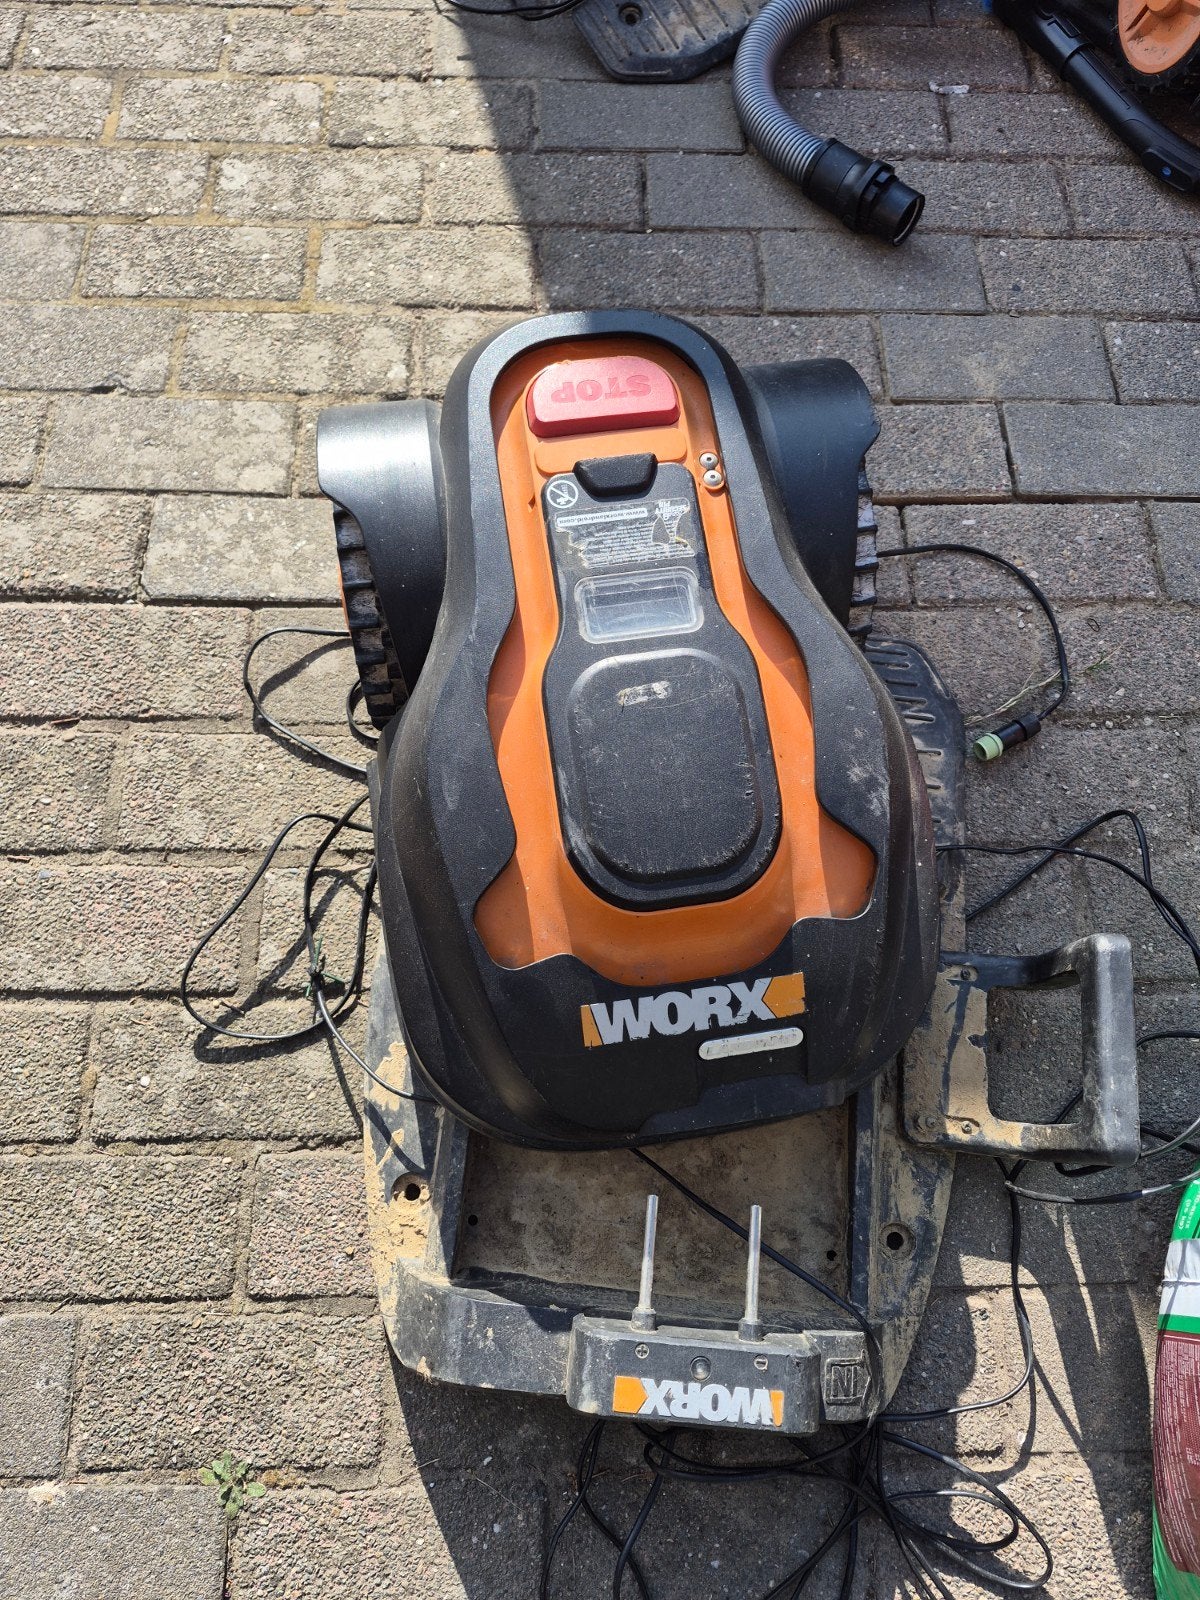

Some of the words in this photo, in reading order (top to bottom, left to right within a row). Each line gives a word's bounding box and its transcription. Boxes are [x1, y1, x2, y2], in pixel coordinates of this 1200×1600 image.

[551, 375, 651, 404] STOP
[590, 977, 775, 1045] WORX
[636, 1377, 773, 1426] WORX
